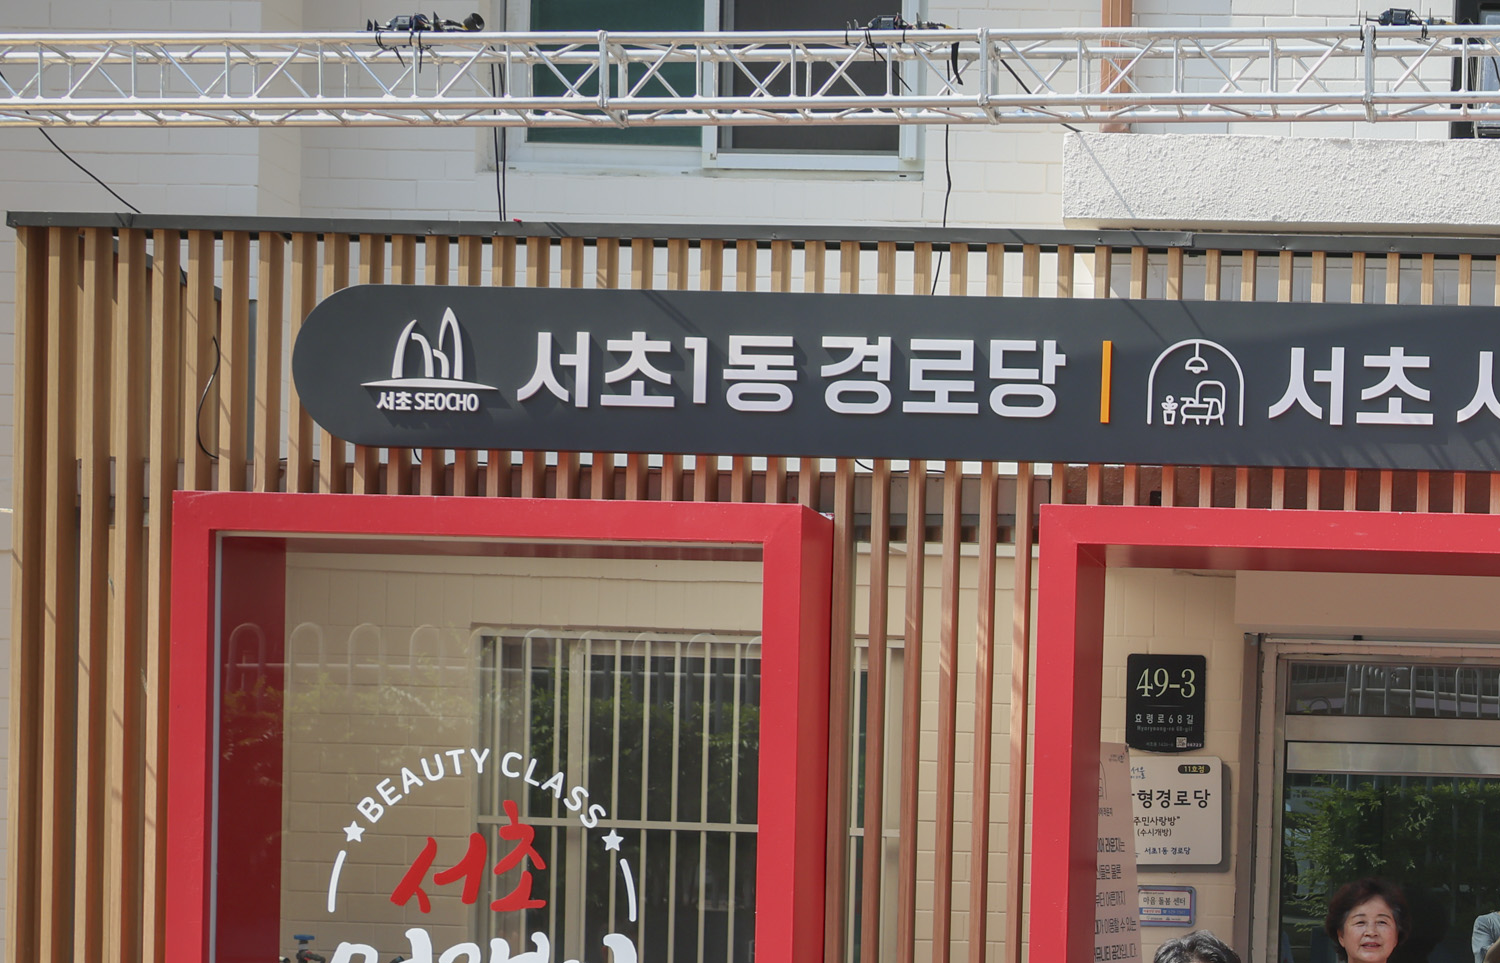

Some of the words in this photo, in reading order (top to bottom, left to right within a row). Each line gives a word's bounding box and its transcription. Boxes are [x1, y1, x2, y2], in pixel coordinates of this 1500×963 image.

[517, 331, 798, 411] 서초1동
[819, 334, 1065, 417] 경로당
[1267, 346, 1433, 427] 서초
[376, 393, 411, 411] 서초
[414, 393, 478, 413] SEOCHO
[1135, 667, 1196, 699] 49-3
[1134, 712, 1194, 725] 효령로68길
[356, 748, 490, 824] BEAUTY
[500, 751, 607, 829] CLASS
[1131, 789, 1211, 809] 형경로당
[390, 800, 546, 914] 서초
[1171, 847, 1191, 855] 경로당
